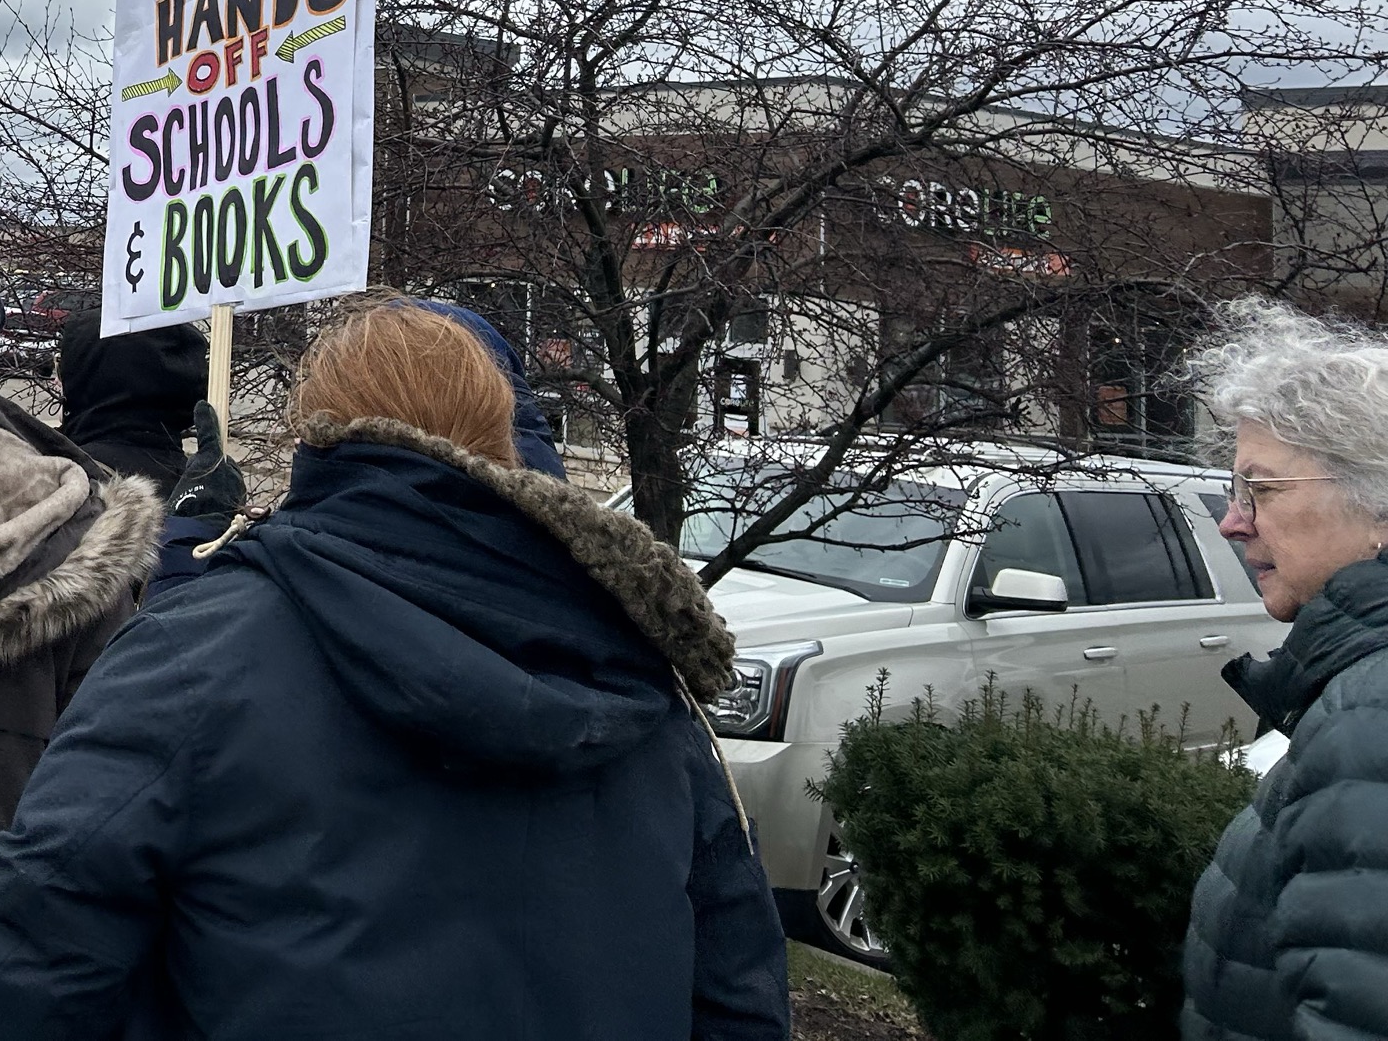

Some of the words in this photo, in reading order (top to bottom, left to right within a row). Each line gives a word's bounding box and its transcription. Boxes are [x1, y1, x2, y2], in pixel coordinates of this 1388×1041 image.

[120, 54, 338, 203] SCHOOLS
[186, 27, 270, 96] OFF
[125, 221, 145, 294] &
[160, 161, 330, 311] BOOKS
